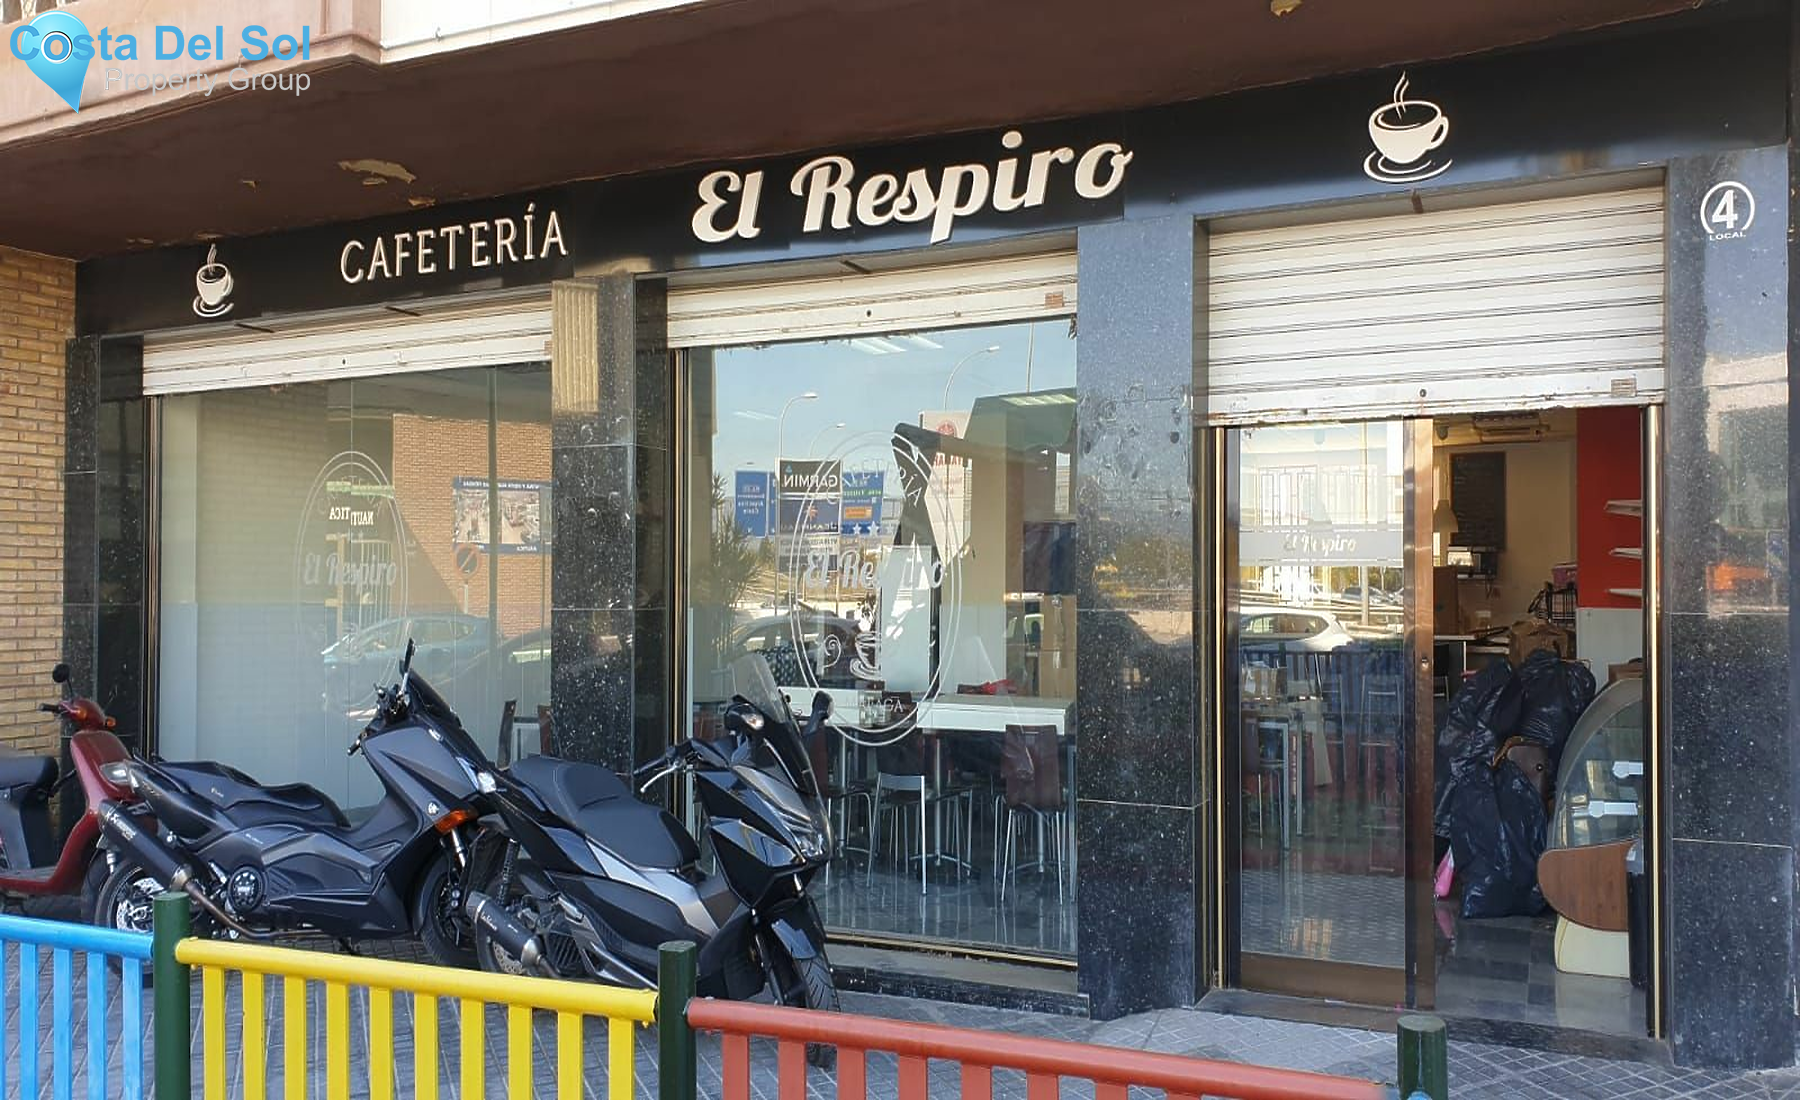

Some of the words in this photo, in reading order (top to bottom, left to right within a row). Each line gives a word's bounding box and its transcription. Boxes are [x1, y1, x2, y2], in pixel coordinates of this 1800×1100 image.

[690, 170, 765, 243] El
[789, 130, 1134, 244] Respiro
[1712, 189, 1738, 229] 4
[340, 202, 569, 284] CAFETERÍA
[1709, 231, 1746, 242] LOCAL
